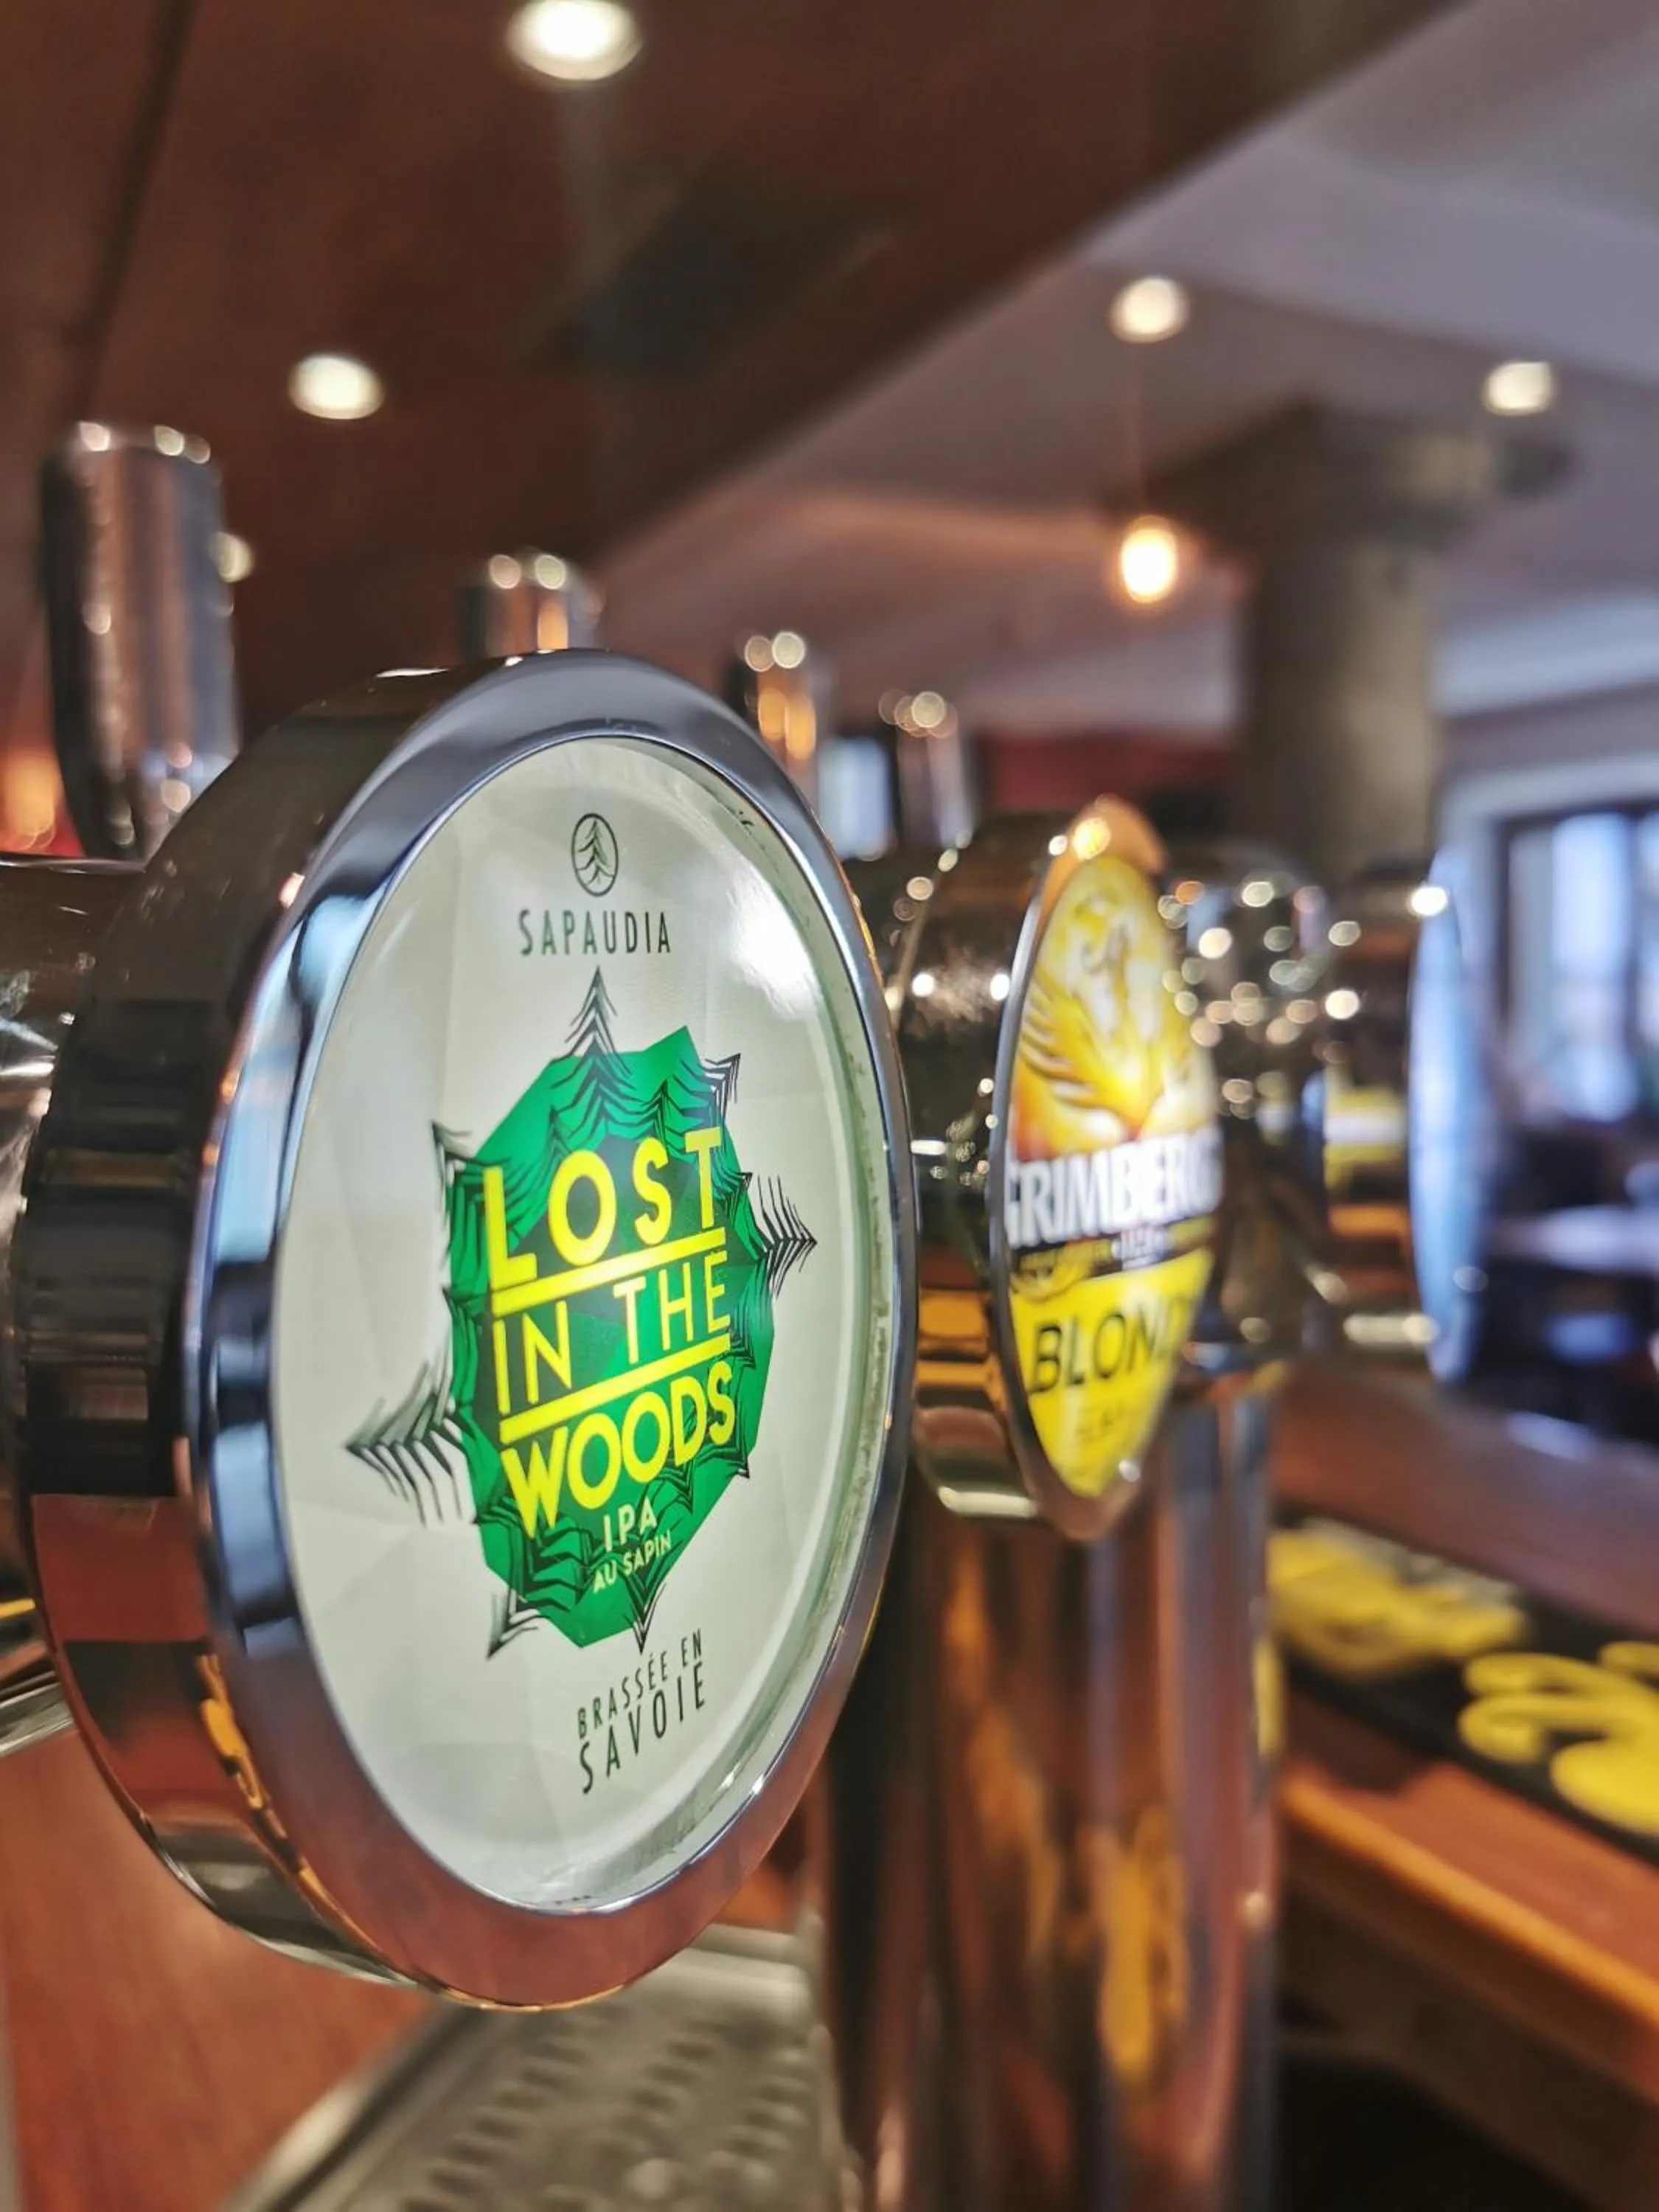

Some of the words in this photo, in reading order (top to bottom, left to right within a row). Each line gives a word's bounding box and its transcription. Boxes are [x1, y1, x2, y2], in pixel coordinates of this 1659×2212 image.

[518, 908, 670, 956] SAPAUDIA
[484, 1127, 721, 1290] LOST
[493, 1301, 571, 1414] IN
[613, 1251, 730, 1364] THE
[501, 1361, 736, 1538] WOODS
[593, 1559, 617, 1594] AU
[623, 1528, 672, 1576] SAPIN
[603, 1495, 658, 1552] IPA
[577, 1653, 668, 1739] BRASSÉE
[681, 1629, 703, 1668] EN
[580, 1663, 706, 1795] SAVOIE
